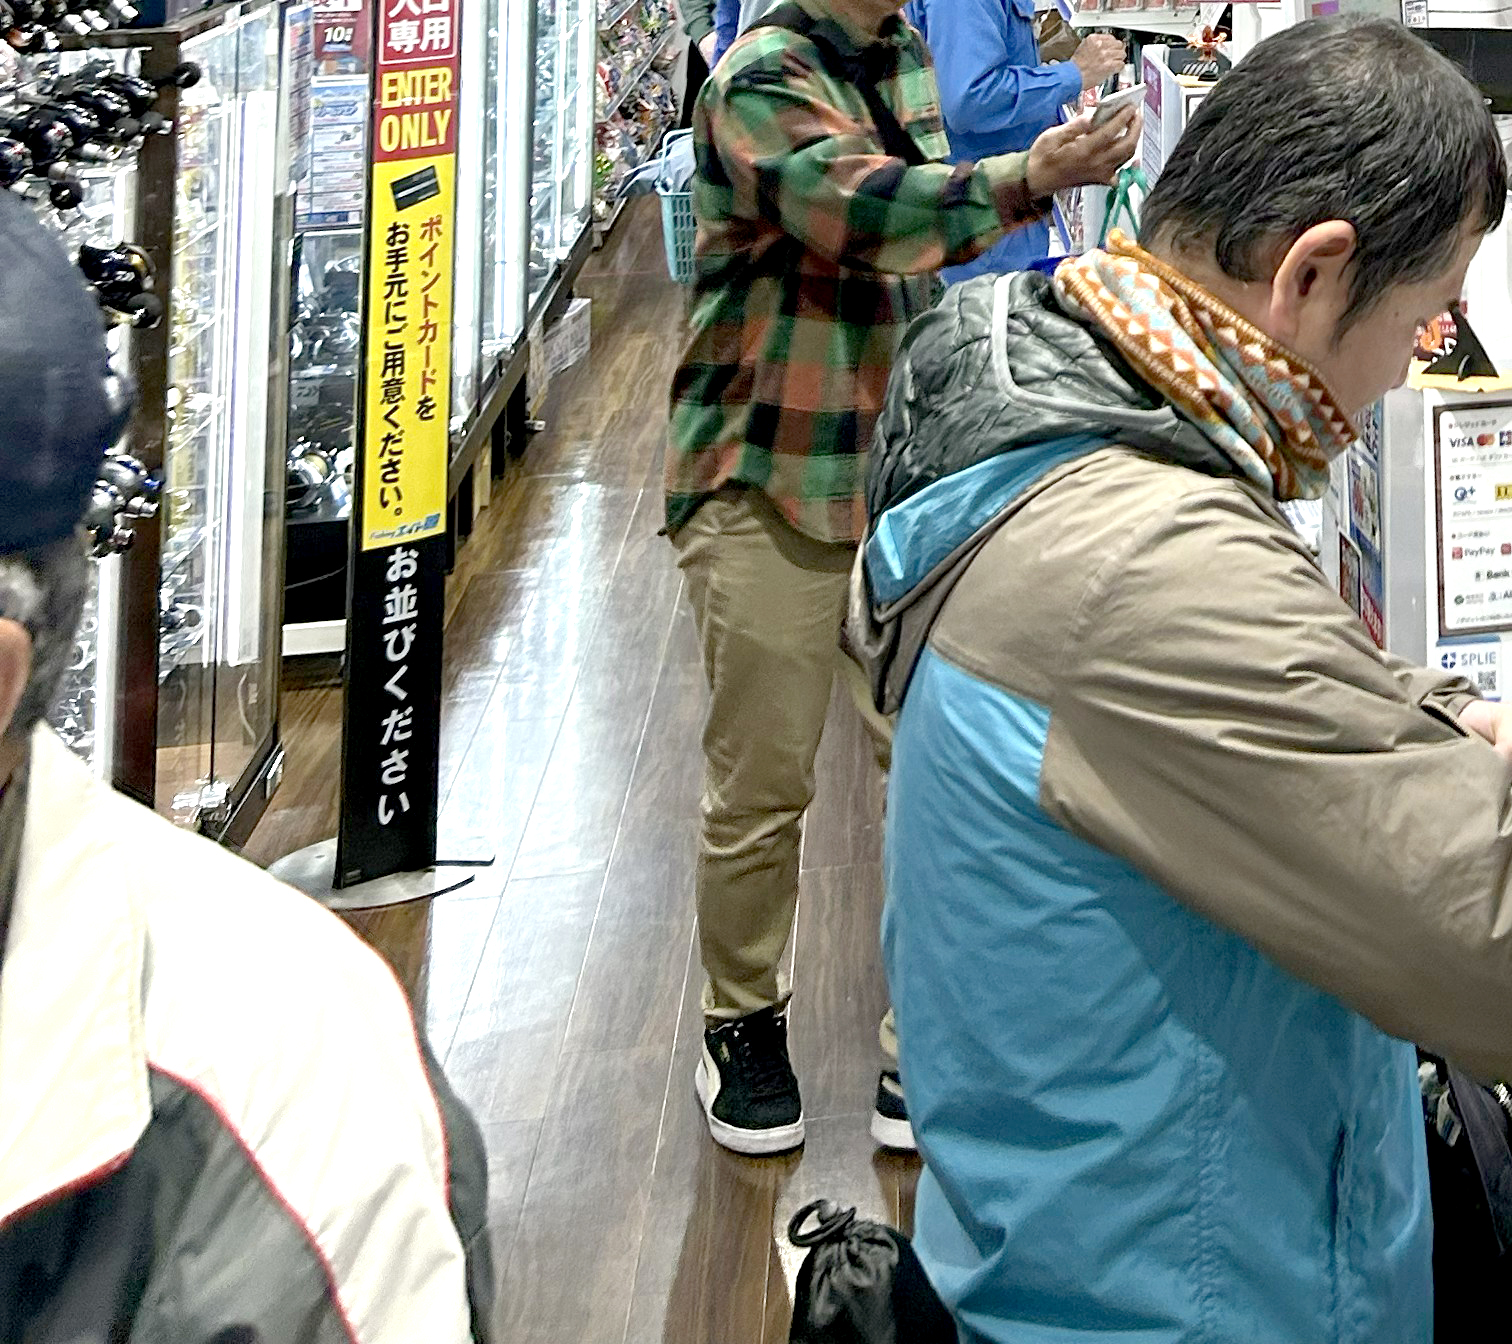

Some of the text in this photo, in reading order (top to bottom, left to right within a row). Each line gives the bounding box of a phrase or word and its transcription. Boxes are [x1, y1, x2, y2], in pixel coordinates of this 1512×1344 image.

[386, 17, 450, 54] 専用
[381, 67, 453, 109] ENTER
[379, 109, 453, 153] ONLY
[415, 214, 443, 422] ポイントカードを
[378, 222, 410, 517] お手元にご用意ください。
[1449, 437, 1475, 448] VISA
[377, 546, 420, 826] お並びください
